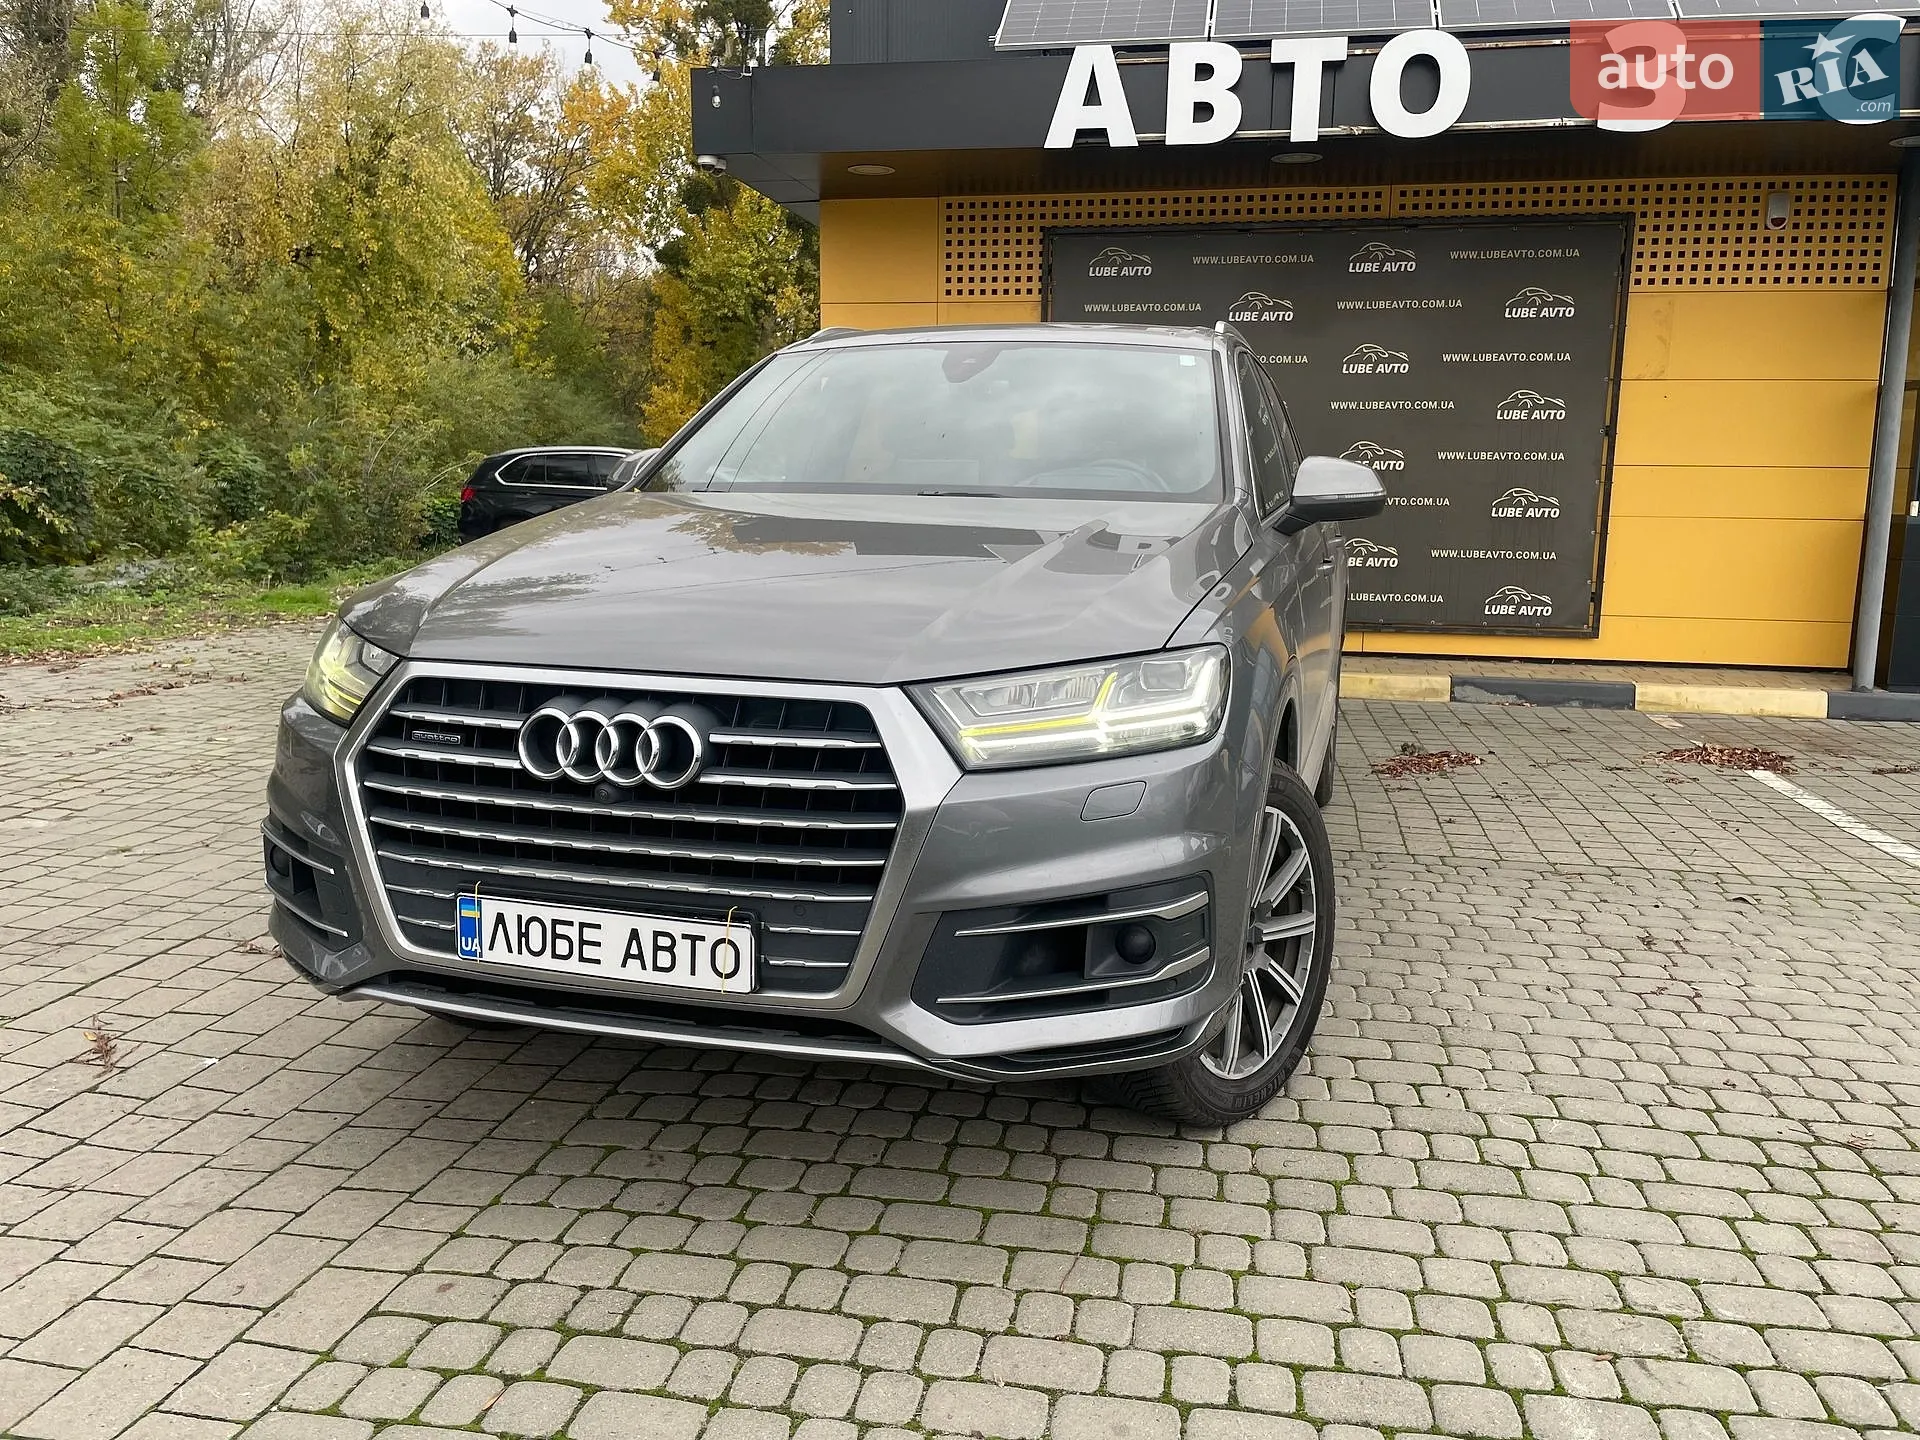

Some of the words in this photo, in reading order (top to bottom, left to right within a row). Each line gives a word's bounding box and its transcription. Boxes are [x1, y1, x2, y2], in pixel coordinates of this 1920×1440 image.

[1043, 29, 1473, 149] АВТО
[1450, 249, 1580, 259] WWW.LUBEAVTO.COM.UA
[1192, 255, 1314, 265] WWW.LUBEAVTO.COM.UA
[1089, 266, 1118, 277] LUBE
[1120, 265, 1152, 277] AVTO
[1349, 261, 1380, 273] LUBE
[1382, 261, 1416, 273] AVTO
[1084, 303, 1202, 312] WWW.LUBEAVTO.COM.UA
[1337, 300, 1463, 309] WWW.LUBEAVTO.COM.UA
[1228, 311, 1259, 322] LUBE
[1261, 311, 1294, 322] AVTO
[1504, 307, 1537, 318] LUBE
[1540, 307, 1575, 318] AVTO
[1442, 353, 1571, 362] WWW.LUBEAVTO.COM.UA
[1342, 363, 1374, 374] LUBE
[1375, 363, 1409, 374] AVTO
[1330, 401, 1455, 410] WWW.LUBEAVTO.COM.UA
[1496, 409, 1529, 420] LUBE
[1531, 409, 1566, 420] AVTO
[1438, 451, 1565, 461] WWW.LUBEAVTO.COM.UA
[1372, 460, 1405, 471] AVTO
[1385, 497, 1450, 506] VTO.COM.UA
[1491, 507, 1523, 518] LUBE
[1525, 507, 1560, 518] AVTO
[1431, 550, 1557, 560] WWW.LUBEAVTO.COM.UA
[1348, 557, 1364, 567] BE
[1365, 557, 1399, 567] AVTO
[1347, 593, 1444, 603] .LUBEAVTO.COM.UA
[1484, 604, 1516, 616] LUBE
[1517, 605, 1552, 616] AVTO
[462, 936, 481, 953] UA
[488, 911, 602, 965] ЛЮБЕ
[620, 928, 741, 980] АВТО
